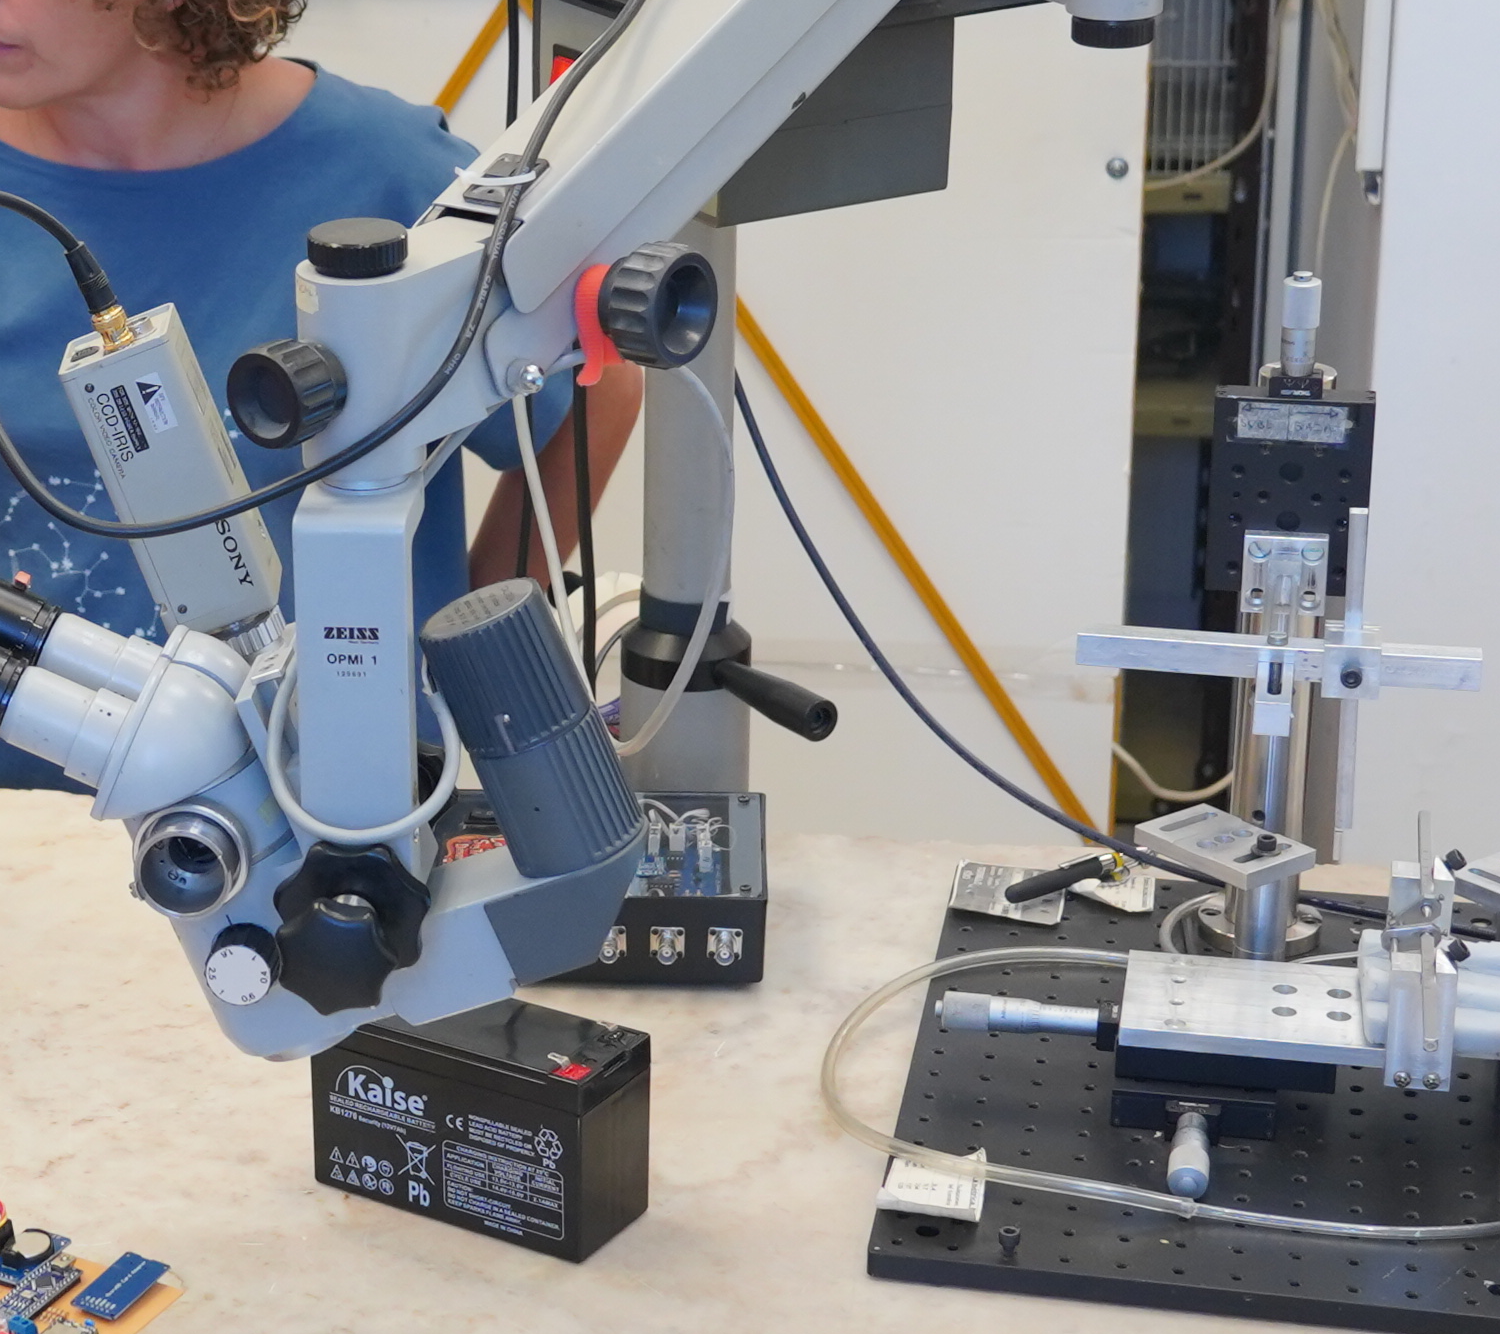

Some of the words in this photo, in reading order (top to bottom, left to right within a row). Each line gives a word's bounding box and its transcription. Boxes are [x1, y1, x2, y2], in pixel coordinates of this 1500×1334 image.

[476, 275, 492, 310] CABLE
[443, 353, 462, 376] OHM
[87, 397, 102, 424] COLOR
[99, 425, 112, 448] VIDEO
[109, 448, 125, 480] CAMERA
[96, 392, 134, 463] CCD-IRIS
[214, 518, 255, 588] SONY
[323, 626, 380, 641] ZEISS
[326, 653, 364, 666] OPMI
[370, 655, 377, 666] 1
[347, 1070, 426, 1116] Kaise
[329, 1094, 354, 1107] SEALED
[354, 1101, 406, 1123] RECHARGEABLE
[329, 1104, 358, 1121] KB1270
[542, 1158, 557, 1170] Pb
[407, 1180, 432, 1208] Pb
